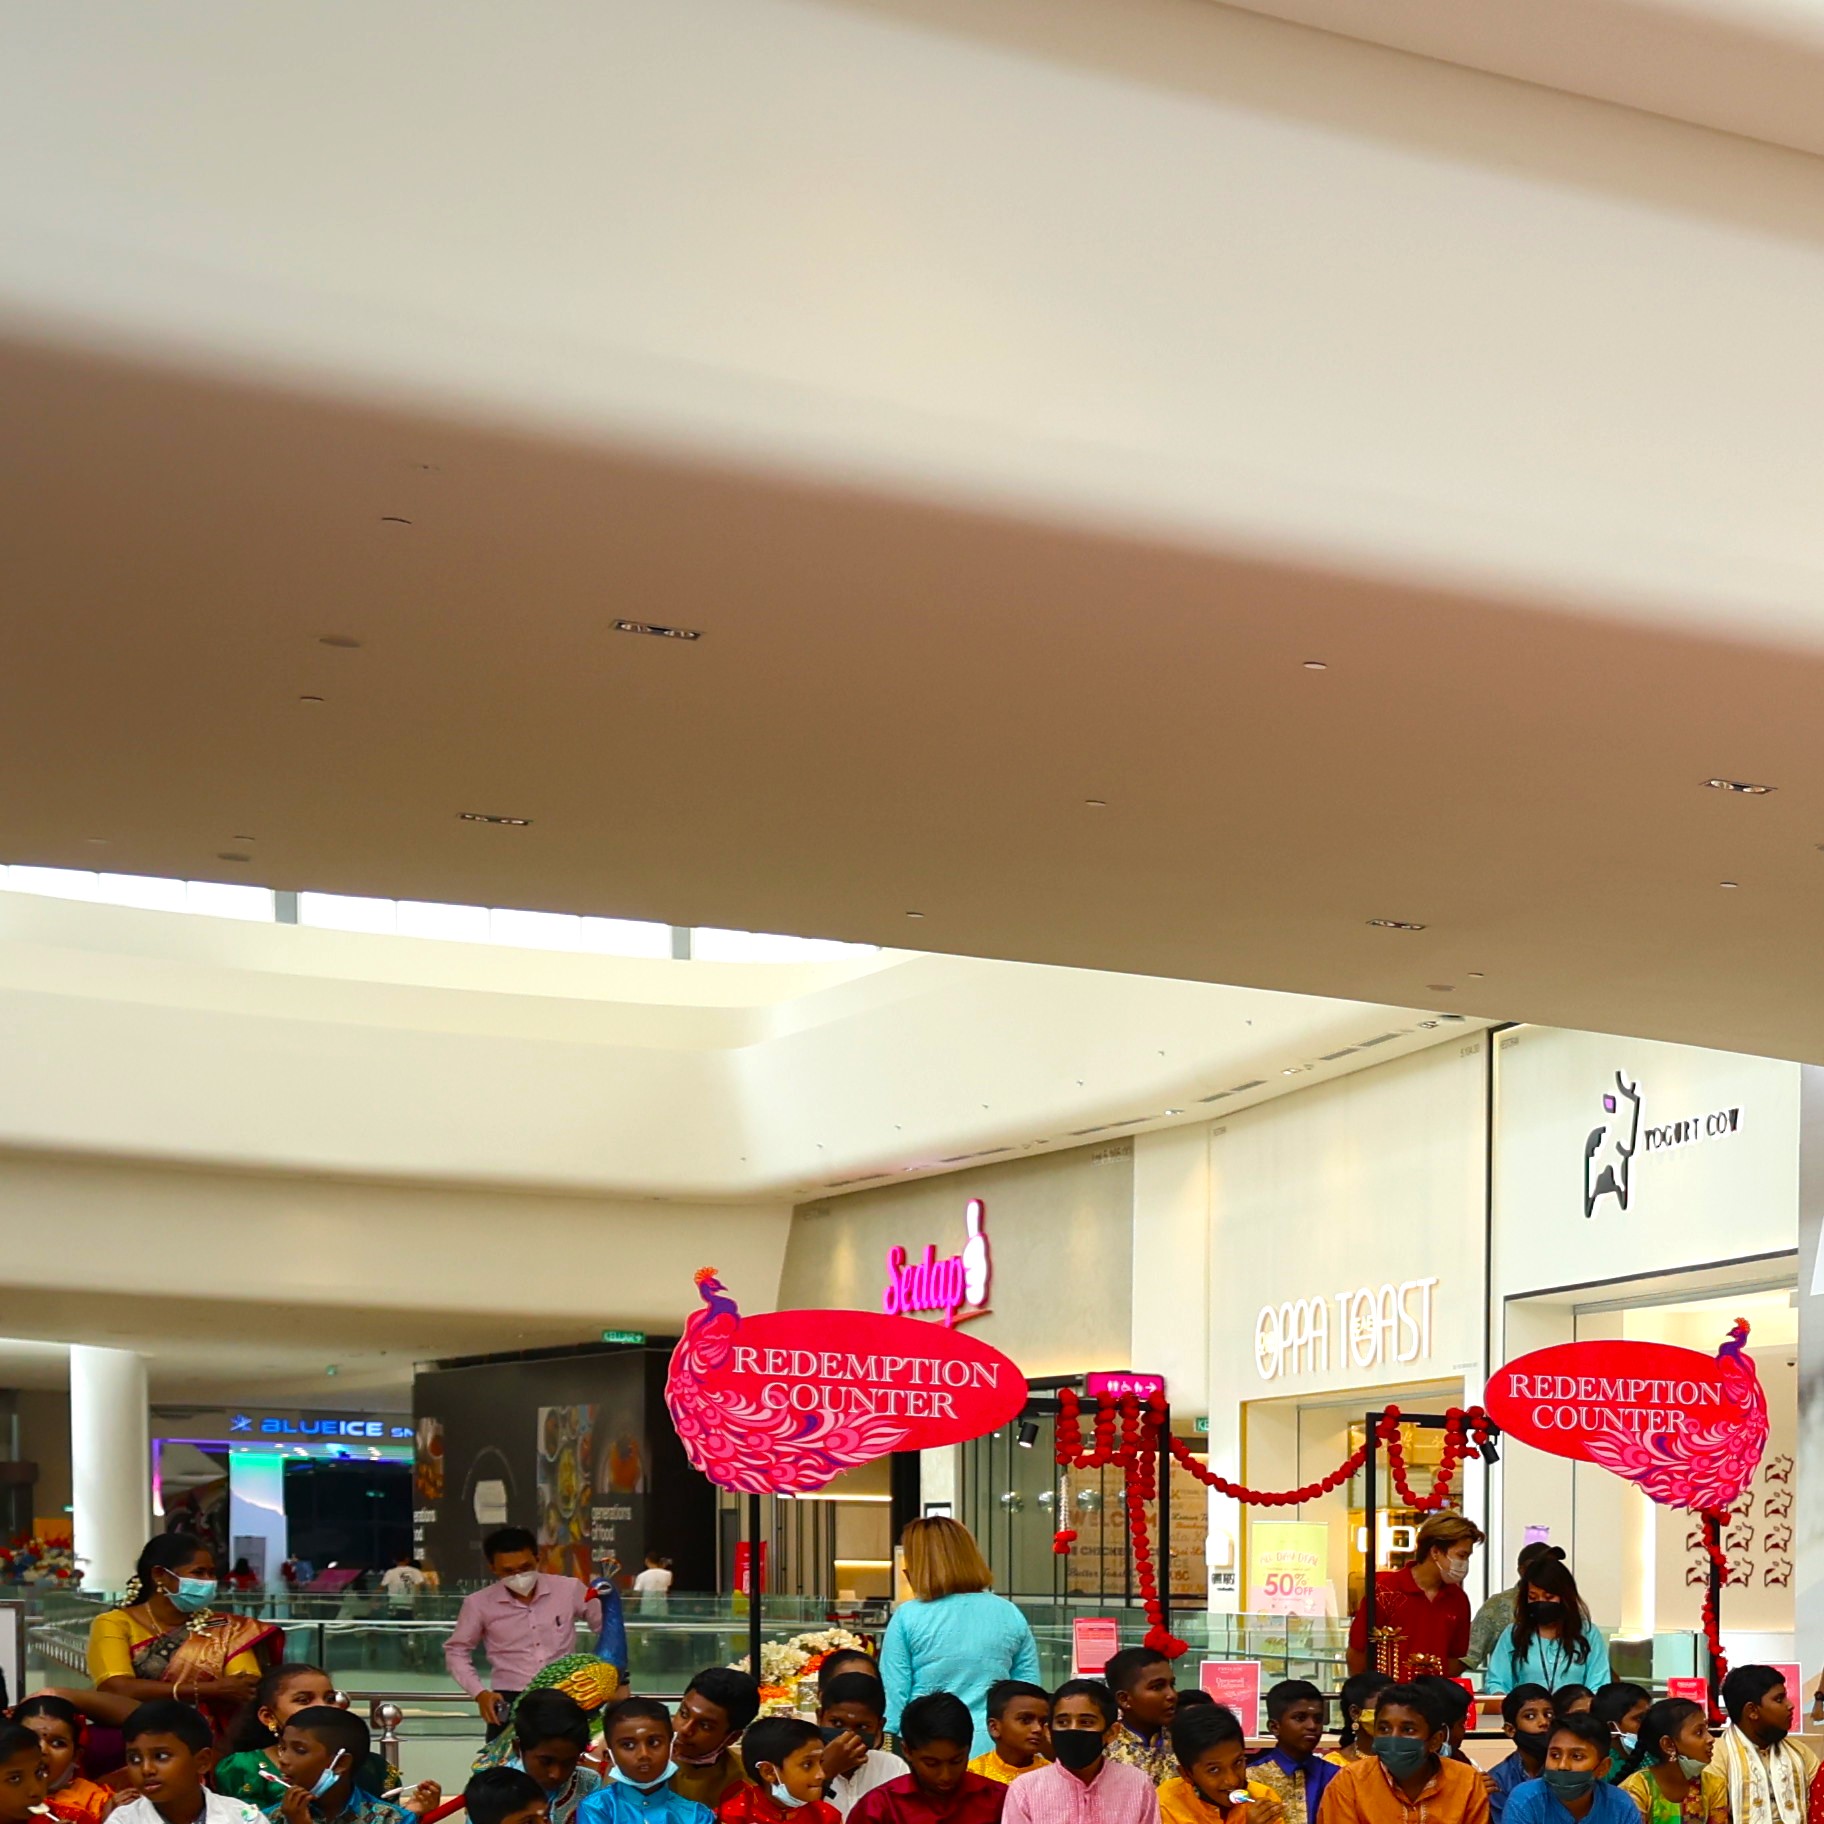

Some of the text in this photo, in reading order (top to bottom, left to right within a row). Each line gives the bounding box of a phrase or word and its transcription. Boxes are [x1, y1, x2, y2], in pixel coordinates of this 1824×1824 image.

[1644, 1107, 1740, 1151] YOGURT COW
[883, 1244, 966, 1327] Sedap
[1255, 1277, 1440, 1380] OPPA TOAST
[732, 1346, 1000, 1390] REDEMPTION
[761, 1382, 959, 1420] COUNTER
[1509, 1374, 1722, 1406] REDEMPTION
[1532, 1405, 1690, 1434] COUNTER
[1295, 1586, 1314, 1596] OFF
